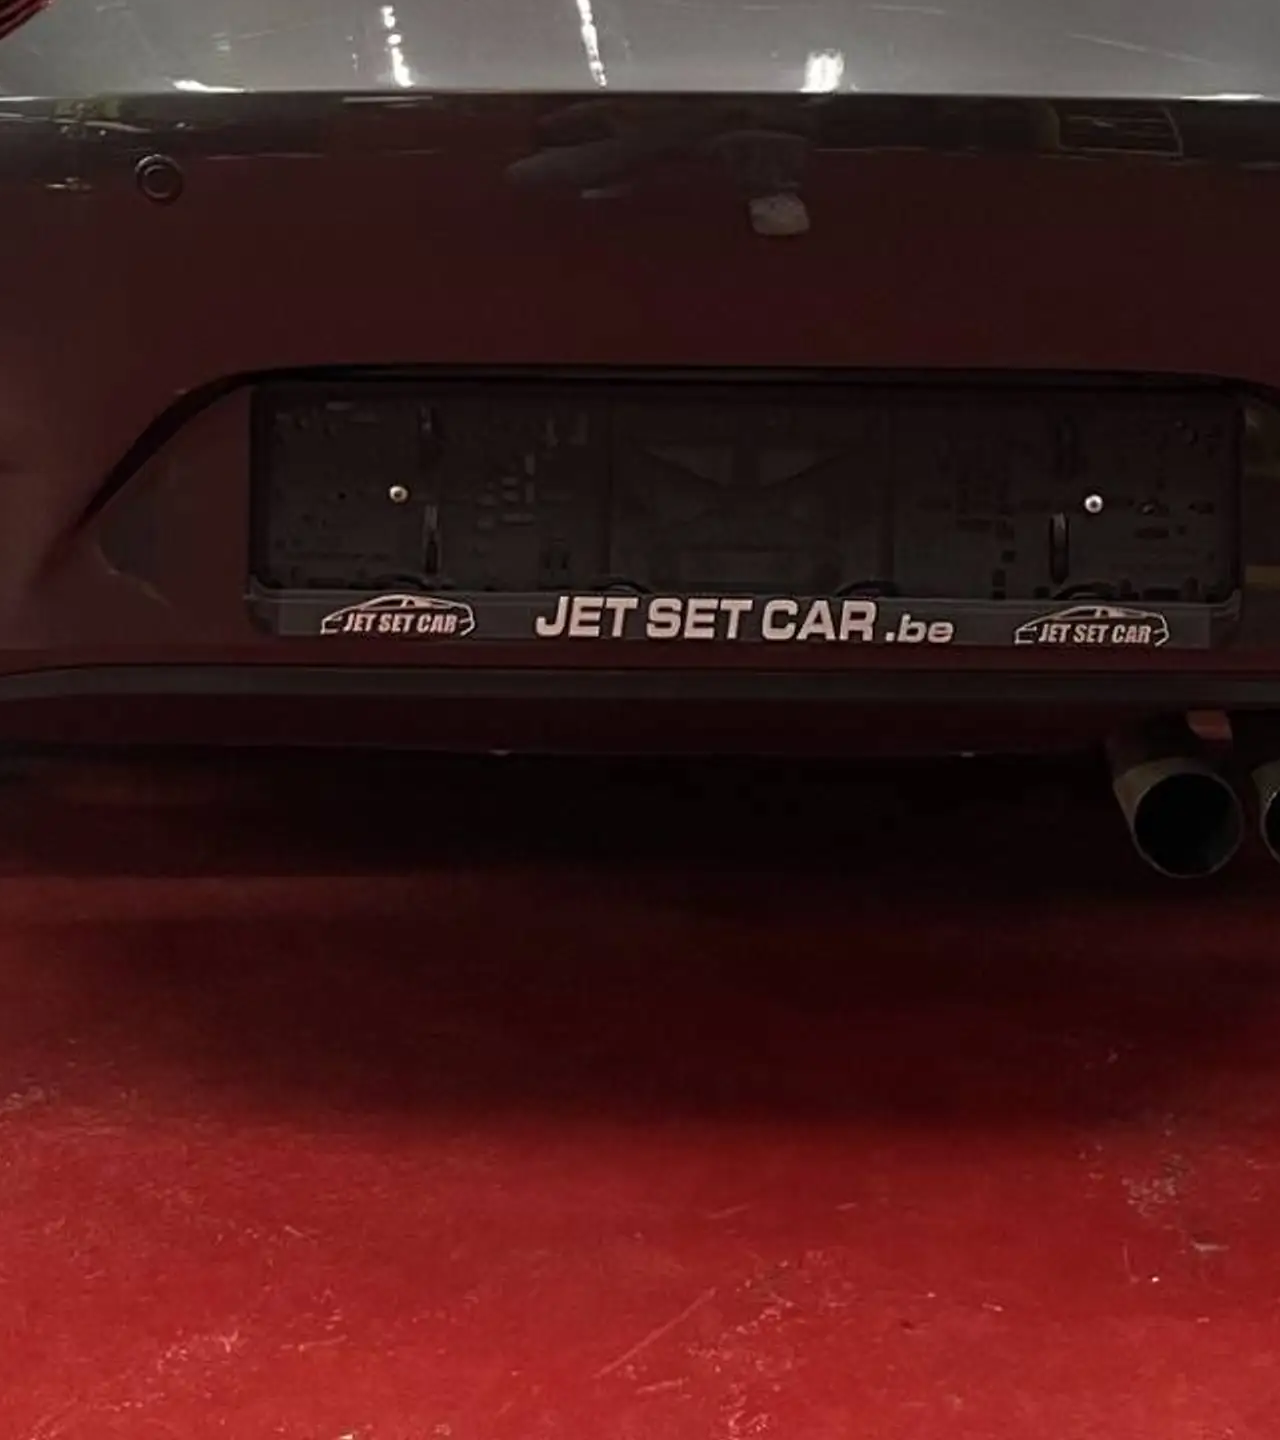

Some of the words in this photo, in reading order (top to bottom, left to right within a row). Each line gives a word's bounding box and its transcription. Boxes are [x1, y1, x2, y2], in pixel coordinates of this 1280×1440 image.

[343, 612, 377, 633] JET
[377, 613, 416, 633] SET
[418, 613, 458, 634] CAR
[535, 595, 639, 637] JET
[645, 595, 753, 639] SET
[760, 599, 878, 642] CAR
[883, 613, 955, 643] .be
[1038, 623, 1073, 642] JET
[1073, 624, 1110, 643] SET
[1112, 624, 1152, 645] CAR
